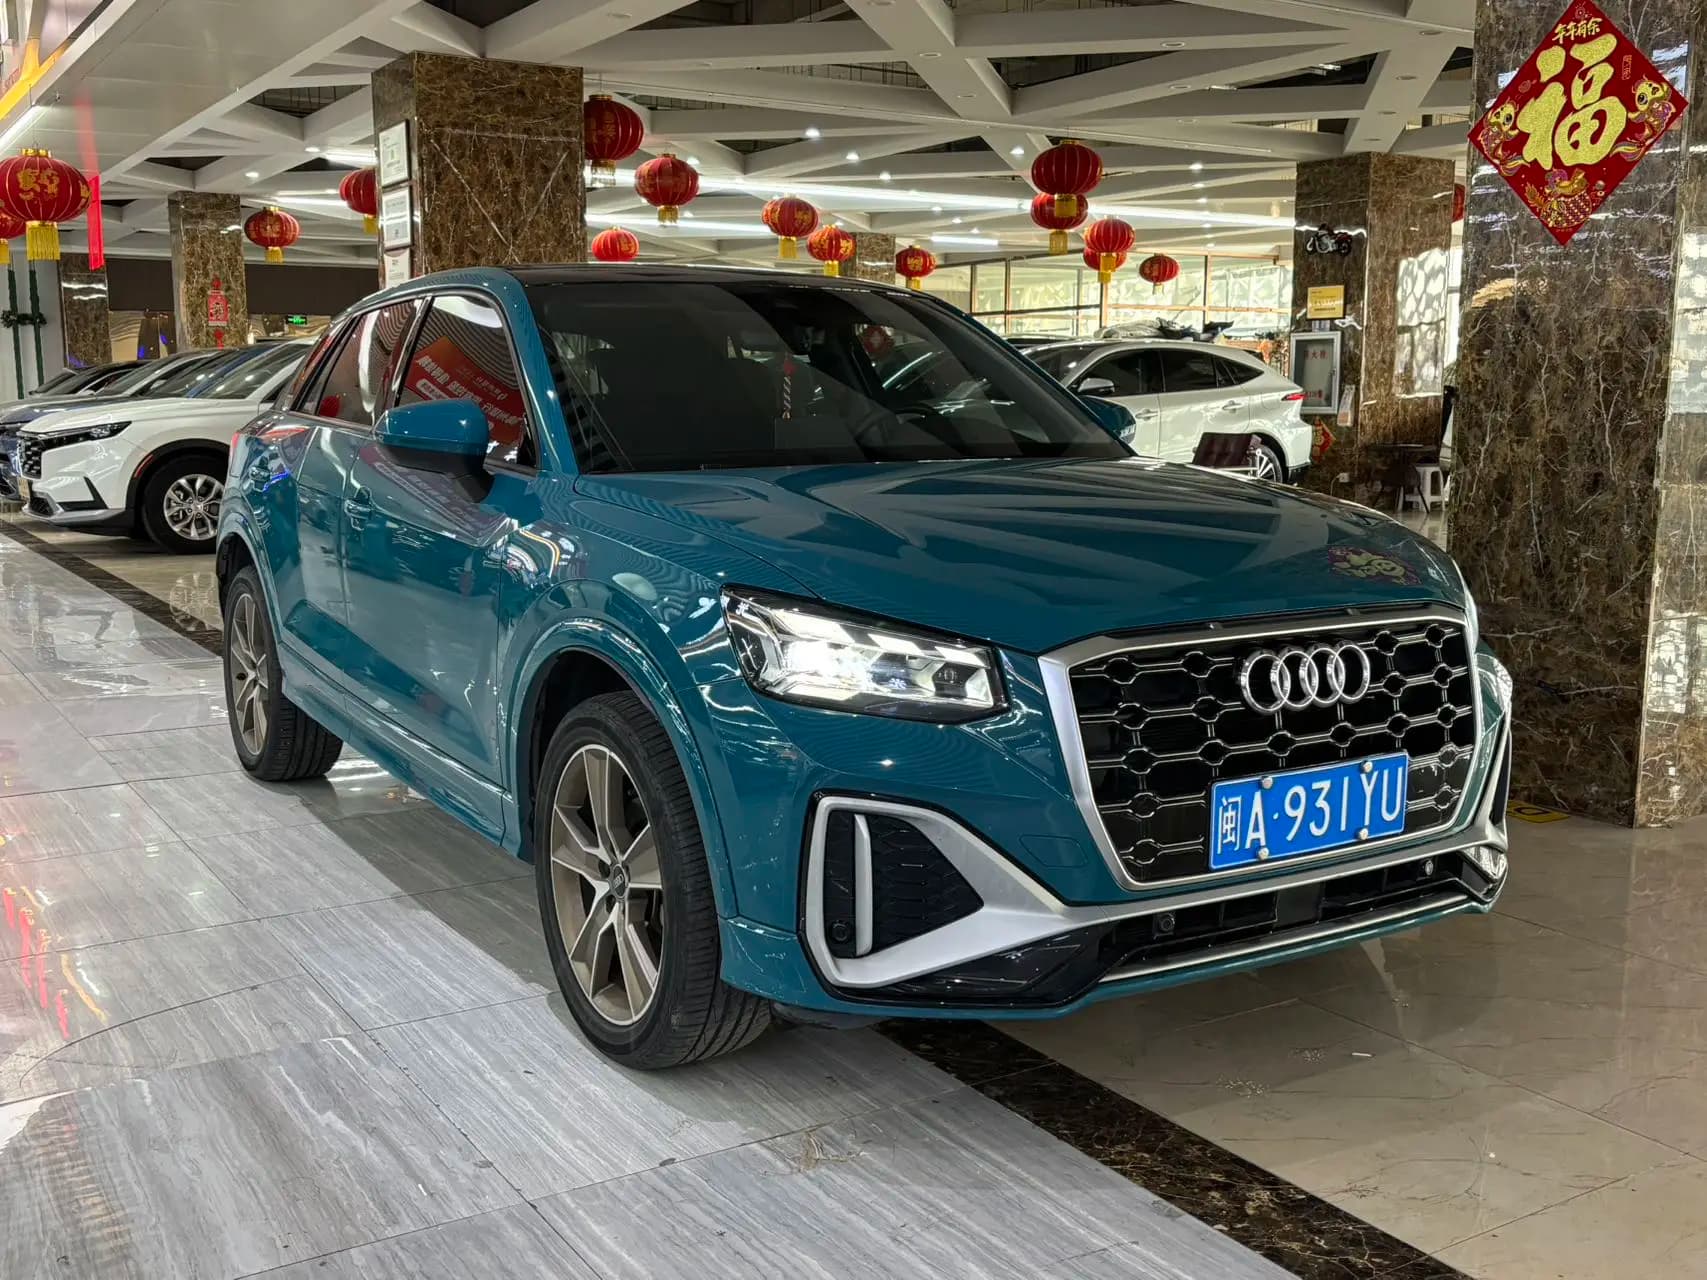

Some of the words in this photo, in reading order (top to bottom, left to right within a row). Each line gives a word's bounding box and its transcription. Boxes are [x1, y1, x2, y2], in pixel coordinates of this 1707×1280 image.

[1551, 17, 1603, 44] 年年有余
[1516, 33, 1627, 171] 福
[1216, 766, 1404, 855] 闽A·931YU
